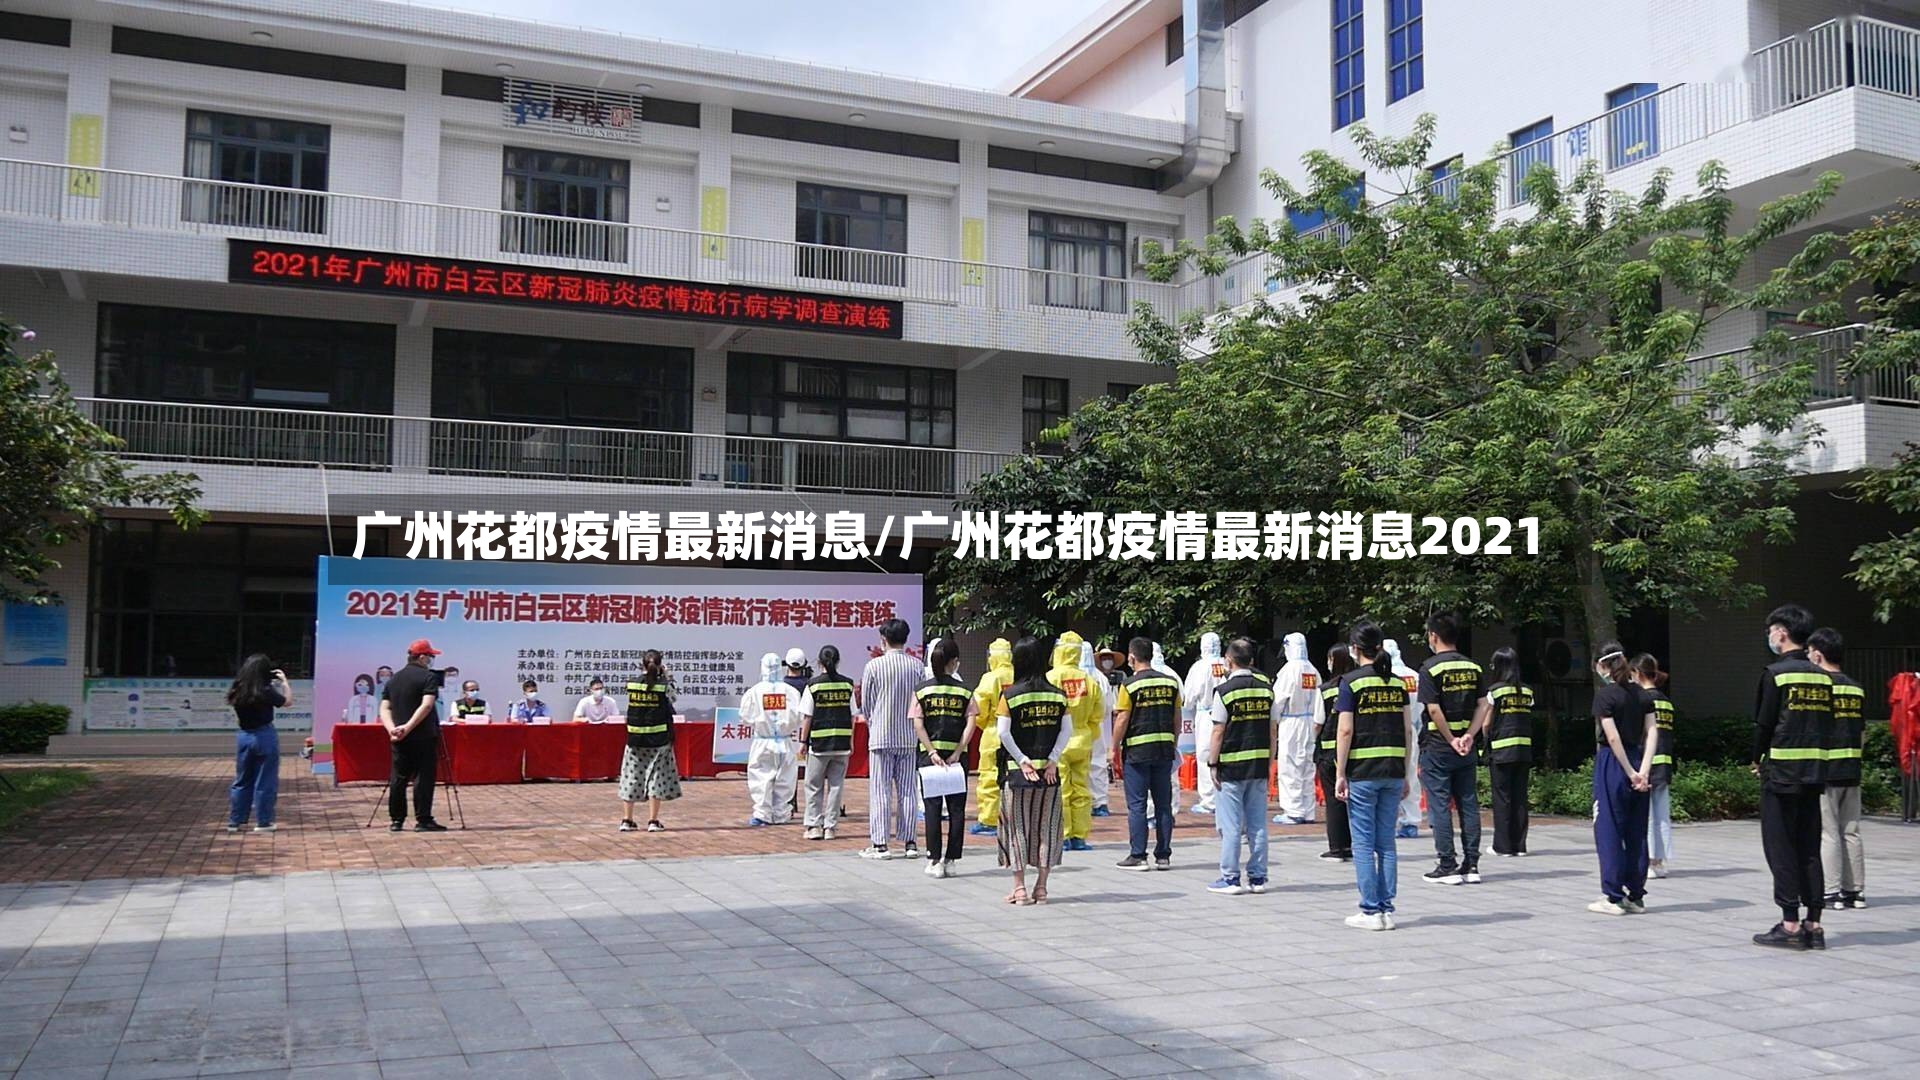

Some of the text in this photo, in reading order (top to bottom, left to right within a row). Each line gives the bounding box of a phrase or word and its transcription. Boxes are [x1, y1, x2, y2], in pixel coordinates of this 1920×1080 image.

[252, 249, 891, 329] 2021年广州市白云区新冠肺炎疫情流行病学调查演练
[347, 590, 896, 627] 2021年广州市白云区新冠肺炎疫情流行病学调查演练
